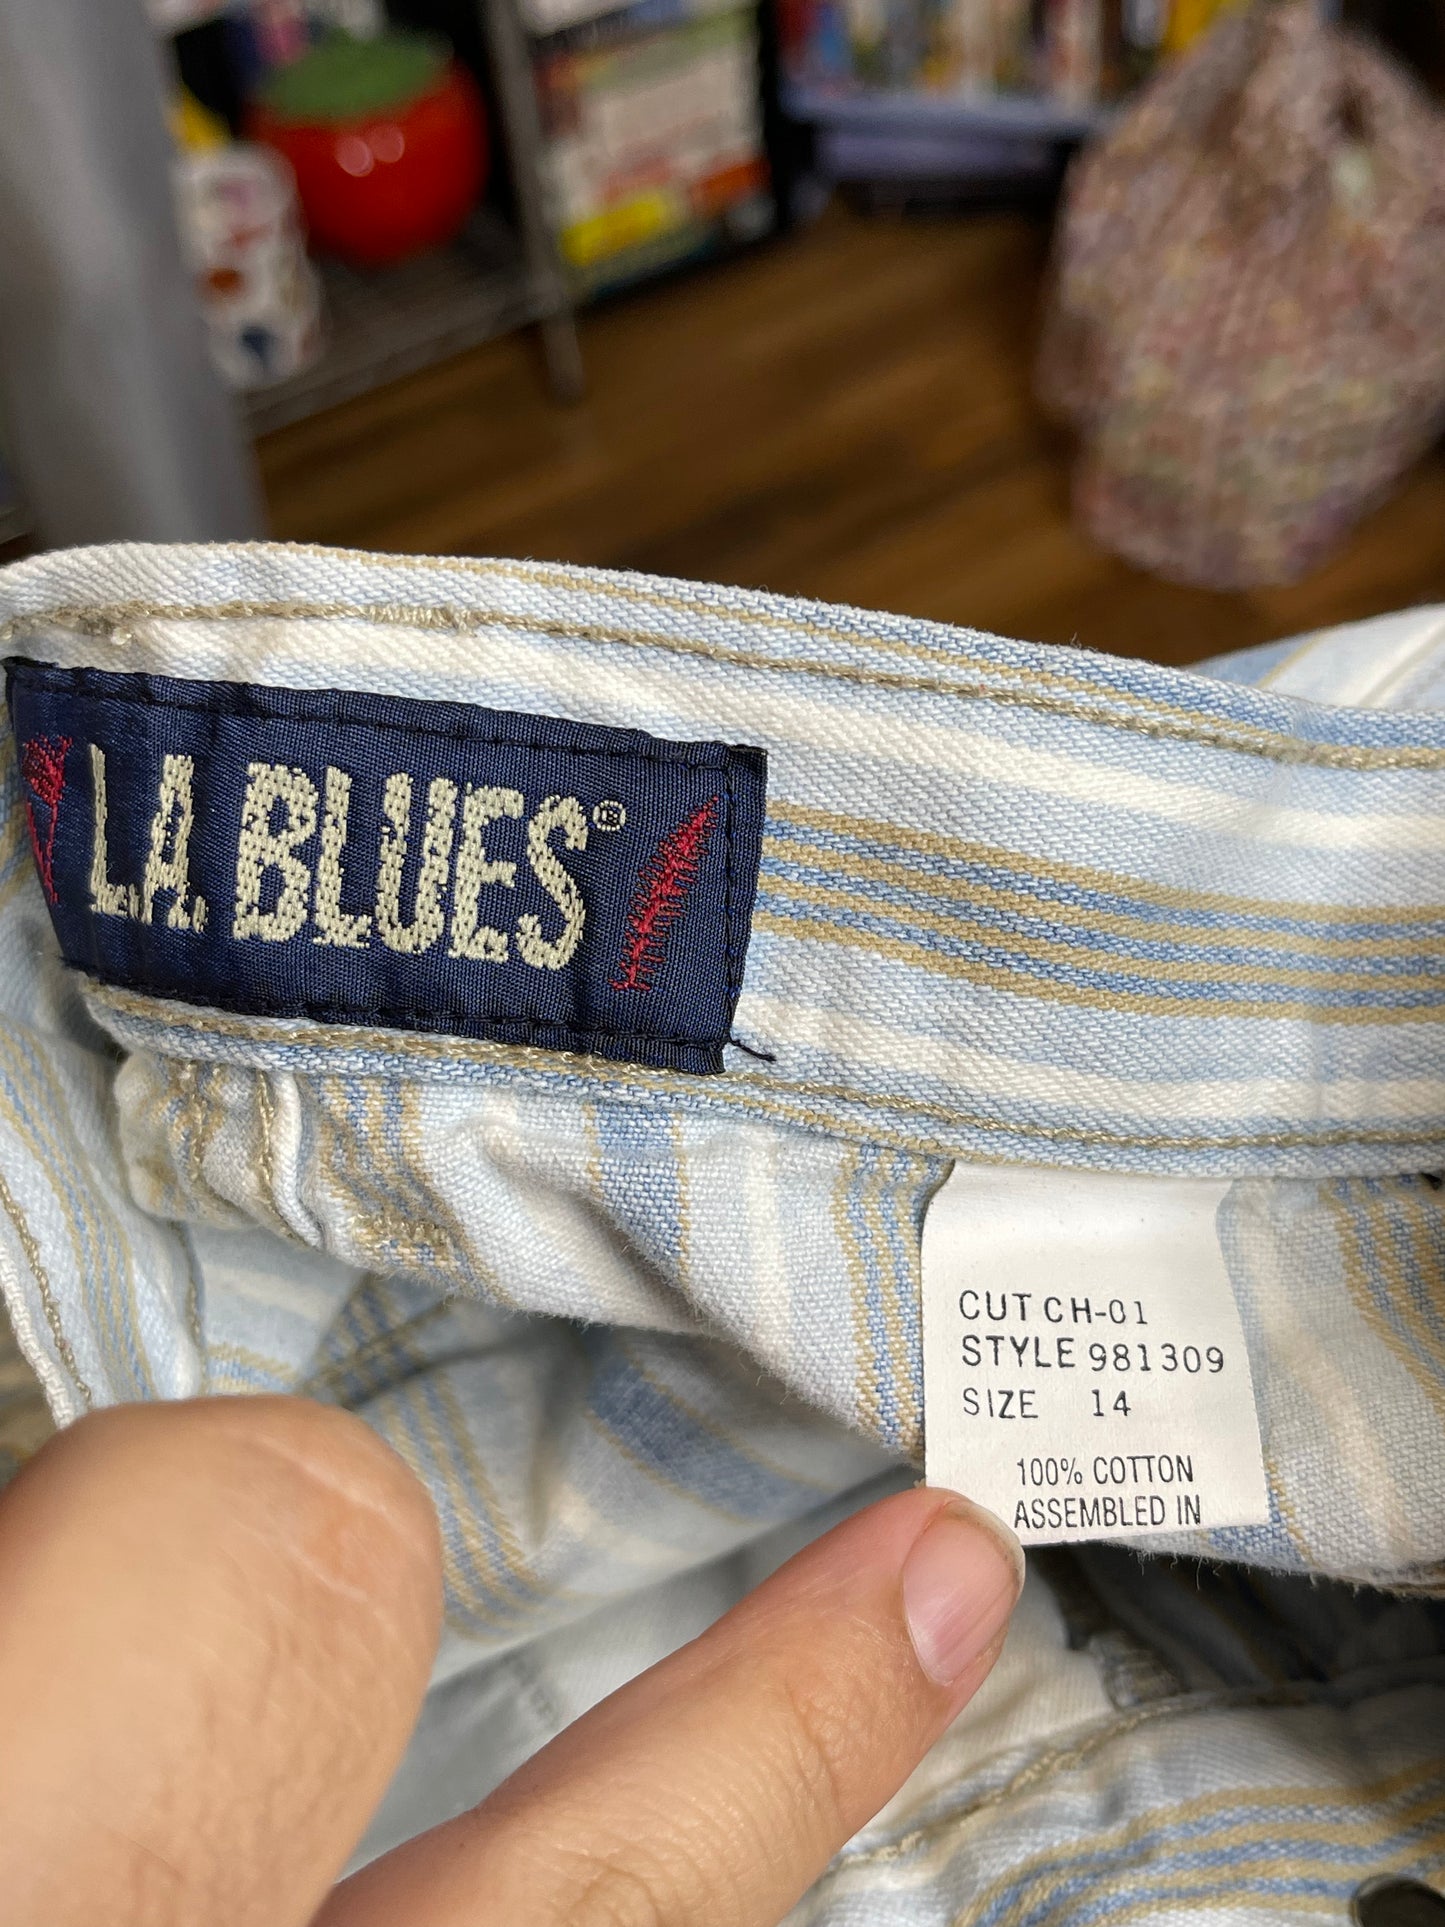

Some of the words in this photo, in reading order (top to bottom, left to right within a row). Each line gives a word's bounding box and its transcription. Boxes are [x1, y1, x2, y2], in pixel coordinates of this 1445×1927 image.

[960, 1289, 1032, 1321] CUT
[1043, 1296, 1149, 1325] CH-01
[961, 1334, 1076, 1368] STYLE
[1089, 1342, 1225, 1373] 981309
[962, 1387, 1039, 1419] SIZE
[1091, 1389, 1132, 1417] 14
[1016, 1457, 1084, 1487] 100%
[1092, 1454, 1194, 1484] COTTON
[1013, 1495, 1167, 1529] ASSEMBLED
[1177, 1494, 1201, 1526] IN
